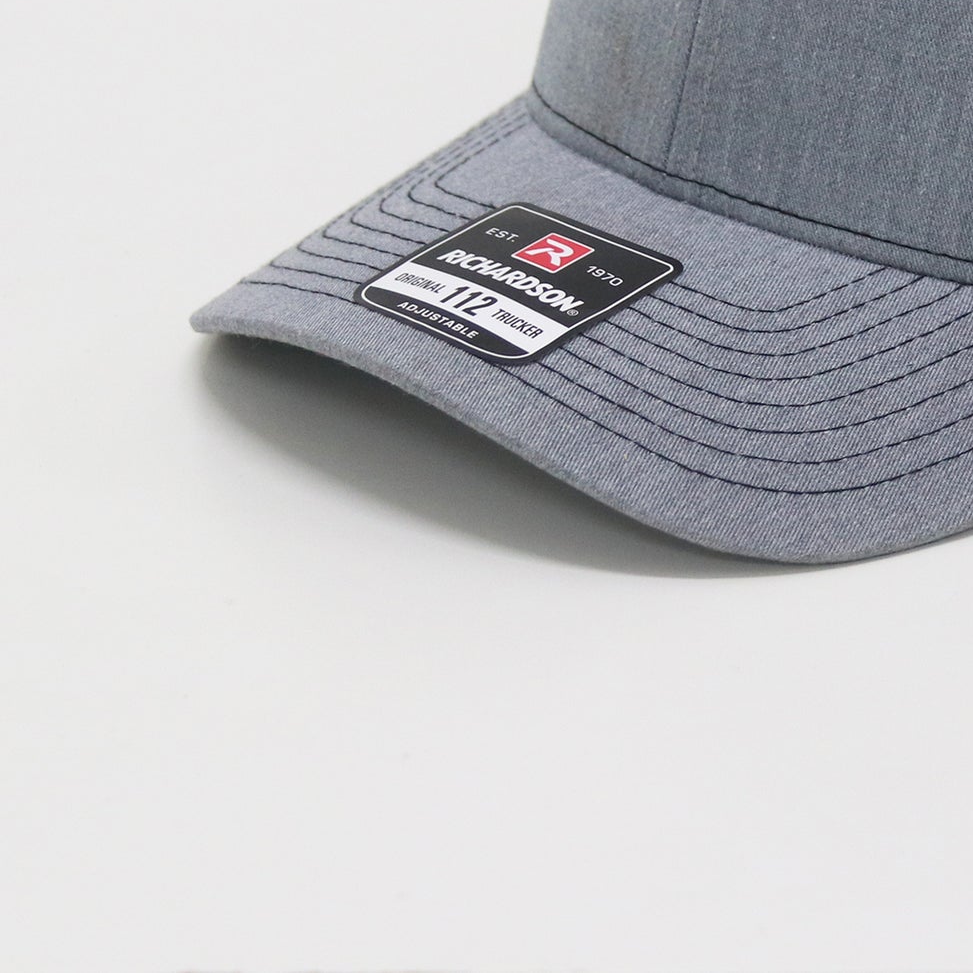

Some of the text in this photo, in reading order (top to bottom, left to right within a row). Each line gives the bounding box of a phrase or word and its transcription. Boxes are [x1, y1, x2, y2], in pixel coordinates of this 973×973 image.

[485, 227, 624, 287] EST. 1970
[525, 238, 575, 267] R
[394, 272, 544, 339] ORIGINAL 112 TRUCKER
[397, 301, 479, 339] ADJUSTABLE
